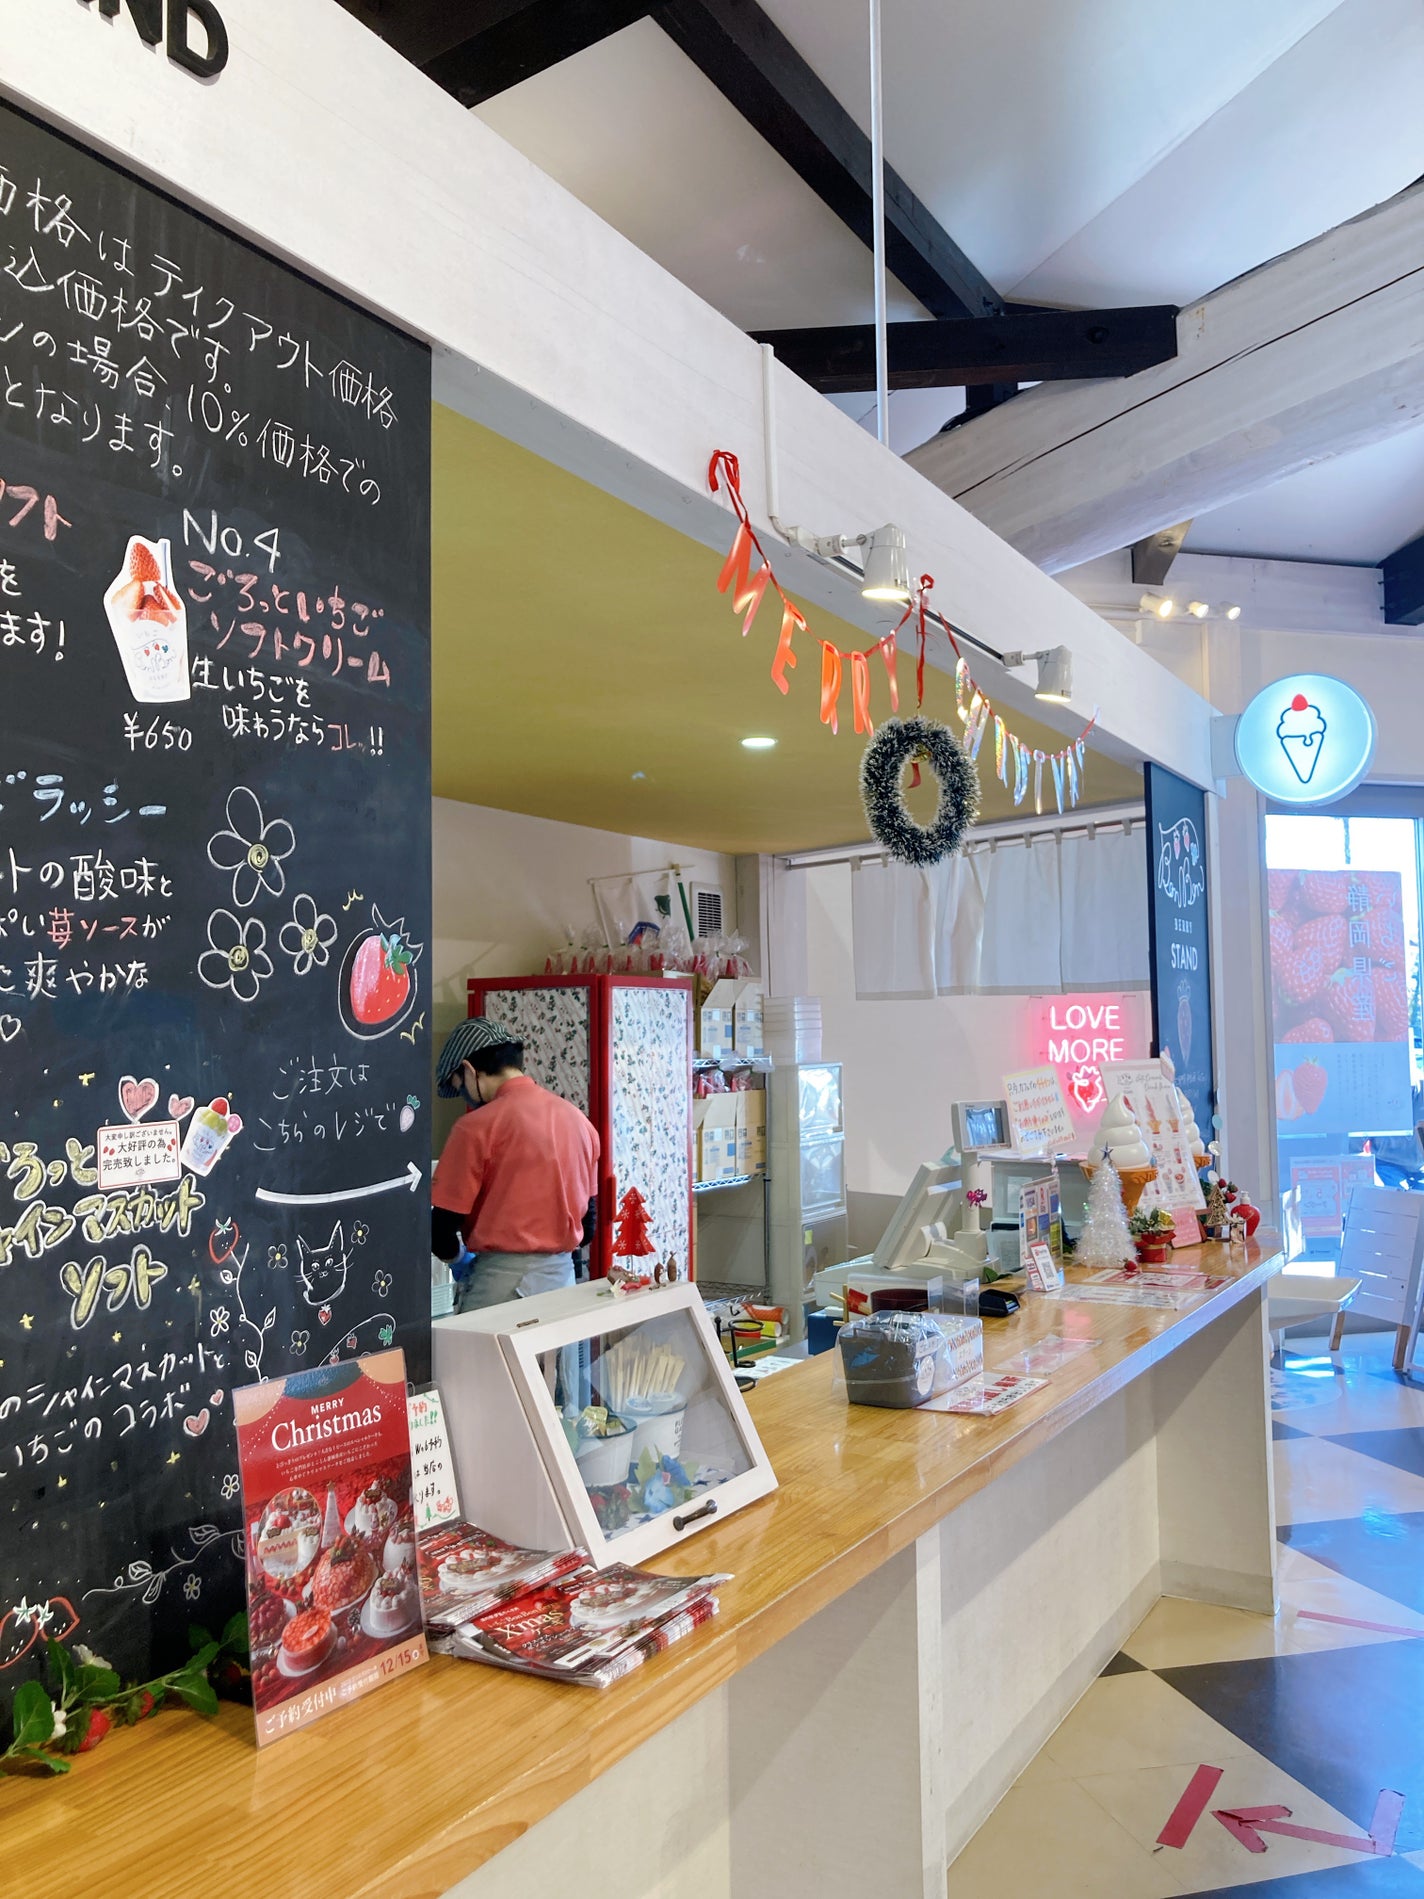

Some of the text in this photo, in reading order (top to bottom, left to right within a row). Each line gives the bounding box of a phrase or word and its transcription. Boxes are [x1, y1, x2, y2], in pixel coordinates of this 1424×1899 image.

[76, 0, 229, 78] ND
[0, 478, 72, 541] フト
[183, 509, 281, 573] No.4
[188, 560, 385, 637] ごろっといちご
[210, 611, 391, 687] ソフトクリーム
[192, 656, 312, 708] 生いちごを
[123, 711, 193, 752] ¥650
[0, 769, 168, 825] ラッシー
[0, 847, 174, 902] トの酸味と
[1170, 942, 1199, 972] STAND
[1049, 1005, 1121, 1031] LOVE
[1048, 1038, 1125, 1063] MORE
[273, 1053, 370, 1100] ご注文は
[118, 1138, 166, 1154] 大好評の為
[253, 1102, 398, 1152] こちらのレジで
[103, 1153, 176, 1171] 完売致しました。
[60, 1244, 168, 1330] ソフト
[271, 1404, 382, 1451] Christmas
[311, 1397, 345, 1415] MERRY
[264, 1686, 337, 1734] ご予約受付中
[380, 1648, 412, 1676] 12/15
